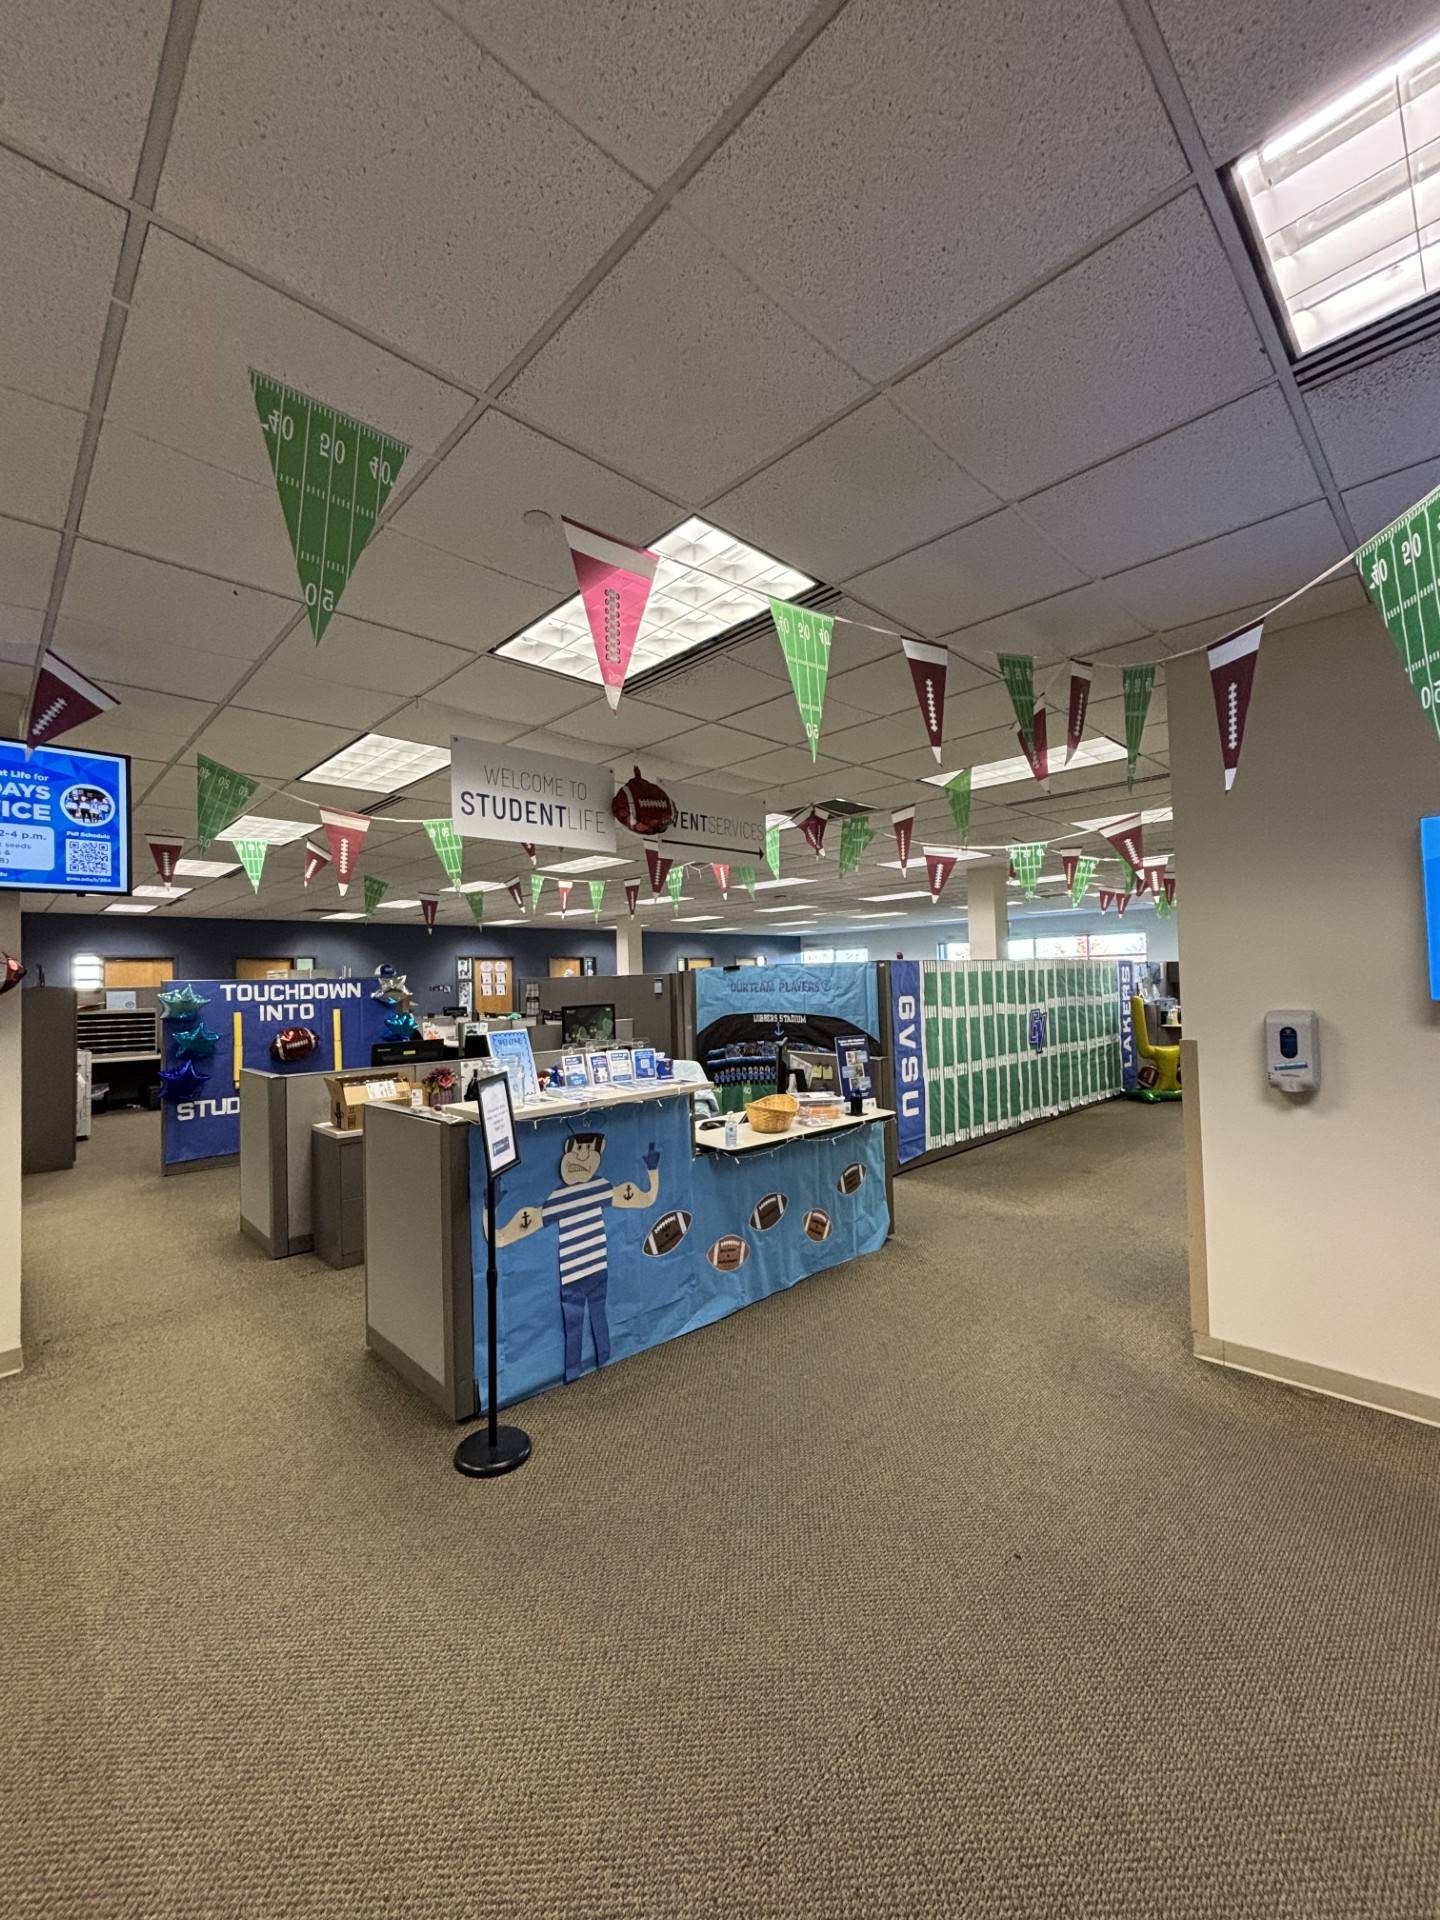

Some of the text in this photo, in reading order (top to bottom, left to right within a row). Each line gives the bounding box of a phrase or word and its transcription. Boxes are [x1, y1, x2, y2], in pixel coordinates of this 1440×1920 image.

[10, 770, 32, 780] Life
[34, 773, 49, 782] for
[483, 765, 588, 801] WELCOME TO
[0, 781, 52, 800] AYS
[219, 982, 362, 1002] TOUCHDOWN
[259, 1003, 315, 1022] INTO
[1121, 965, 1133, 1069] LAKERS
[898, 995, 920, 1118] GVSU
[176, 1097, 240, 1122] STUD
